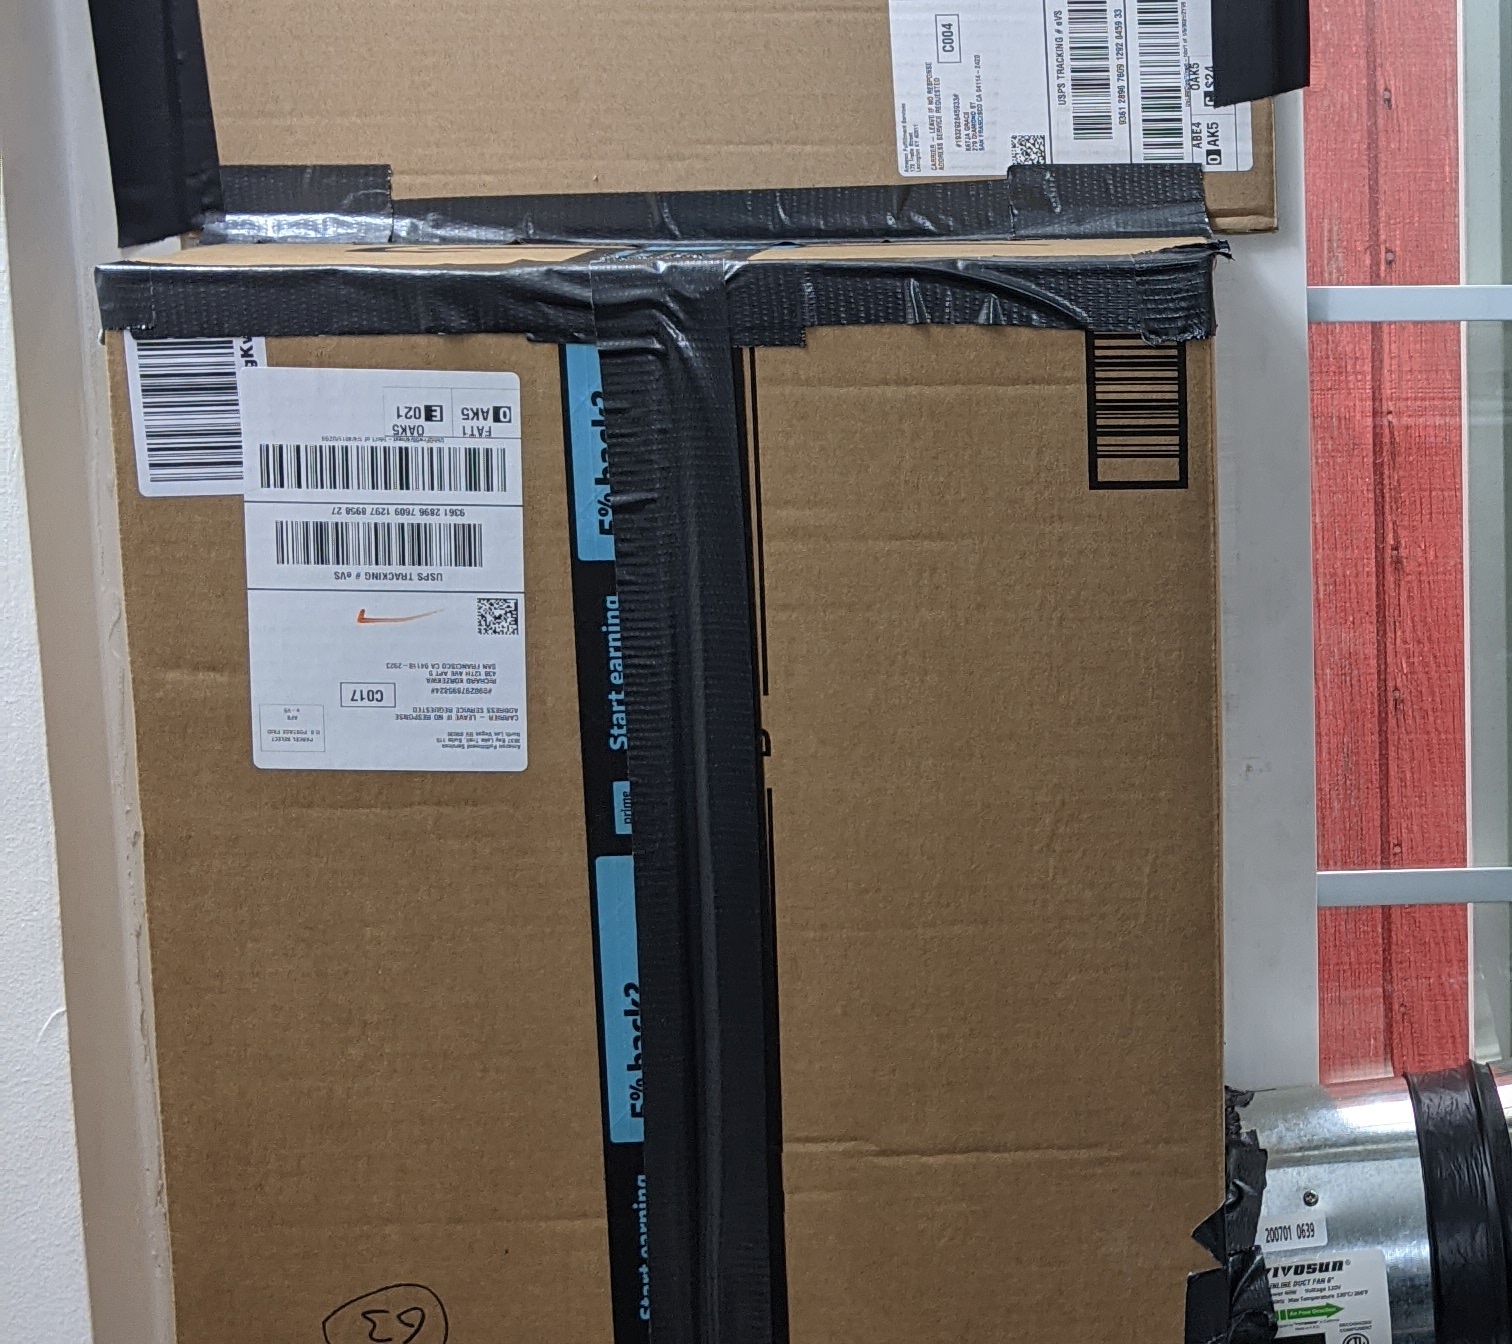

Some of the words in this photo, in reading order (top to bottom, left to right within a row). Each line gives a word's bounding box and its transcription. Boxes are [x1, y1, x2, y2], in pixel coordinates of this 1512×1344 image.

[1114, 9, 1122, 18] 33
[941, 23, 954, 53] C004
[1055, 37, 1065, 79] TRACKING
[1057, 83, 1066, 105] USPS
[1207, 122, 1219, 147] AK5
[396, 406, 422, 419] 021
[461, 407, 490, 421] AK5
[462, 426, 492, 436] FAT1
[332, 507, 342, 515] 27
[344, 507, 366, 515] 8958
[395, 508, 415, 516] 7609
[420, 508, 440, 516] 2896
[444, 508, 466, 516] 9361
[334, 572, 352, 580] eVS
[365, 572, 413, 581] TRACKING
[417, 572, 443, 581] USPS
[350, 689, 384, 701] C017
[609, 691, 628, 750] Start
[1265, 1226, 1292, 1243] 200701
[1296, 1223, 1315, 1240] 0639
